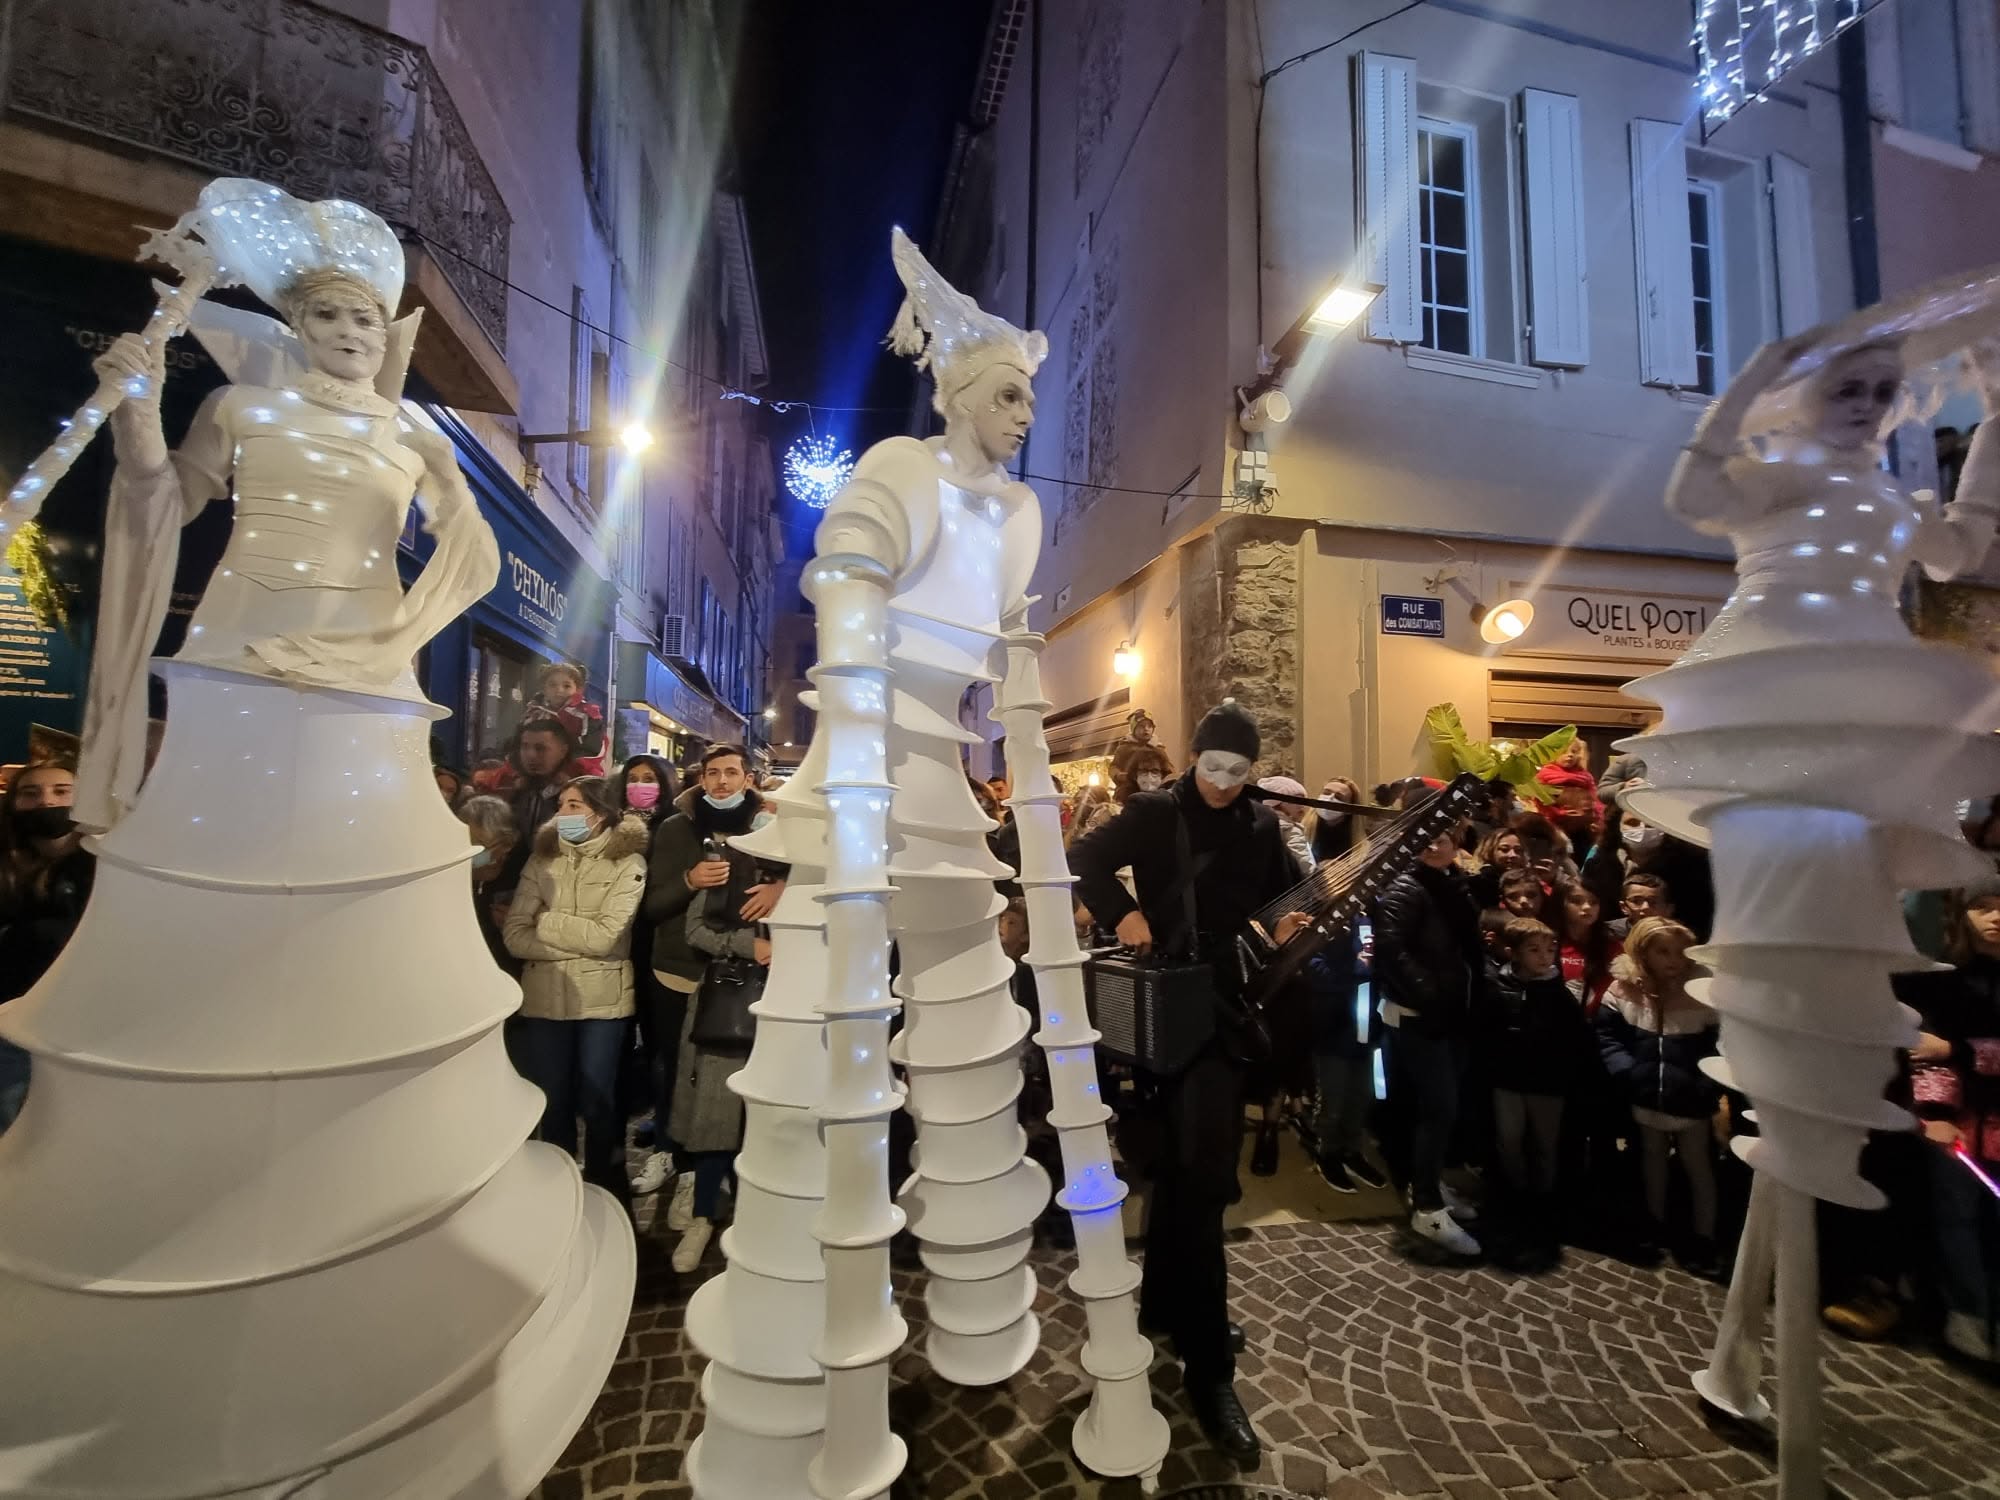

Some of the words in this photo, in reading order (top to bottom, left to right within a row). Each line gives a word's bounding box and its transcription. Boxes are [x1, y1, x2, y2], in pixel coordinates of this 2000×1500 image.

[1402, 602, 1425, 615] RUE
[1568, 597, 1637, 635] QUEL
[1385, 617, 1397, 628] des
[1398, 617, 1441, 631] COMBATTANTS
[1604, 635, 1644, 648] PLANTES
